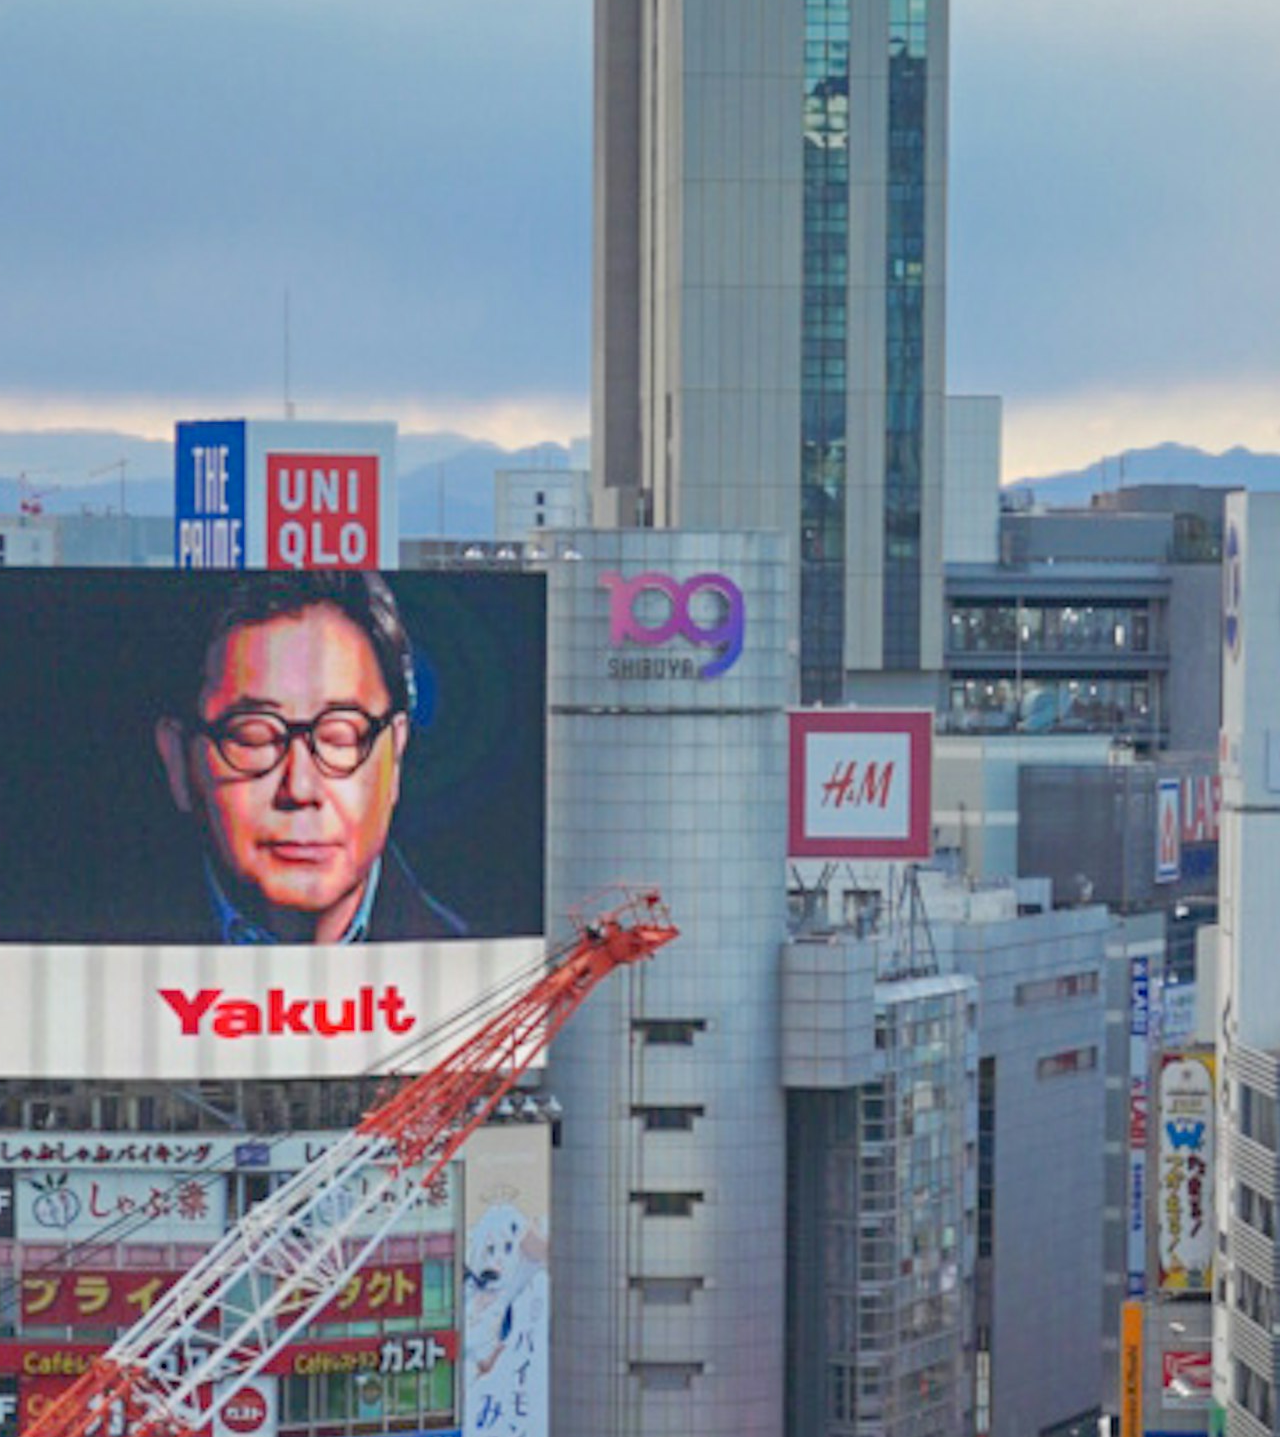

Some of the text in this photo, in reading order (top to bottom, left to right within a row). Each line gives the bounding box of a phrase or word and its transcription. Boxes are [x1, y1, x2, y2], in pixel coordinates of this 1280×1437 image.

[192, 444, 229, 514] THE
[278, 468, 359, 513] UNI
[277, 519, 368, 569] QLO
[597, 570, 746, 682] 109
[608, 658, 695, 681] SHIBUYA
[821, 760, 895, 809] H&M
[157, 986, 417, 1039] Yakult
[0, 1141, 213, 1164] しゃぶしゃぶバイキング
[380, 1337, 447, 1374] ガスト
